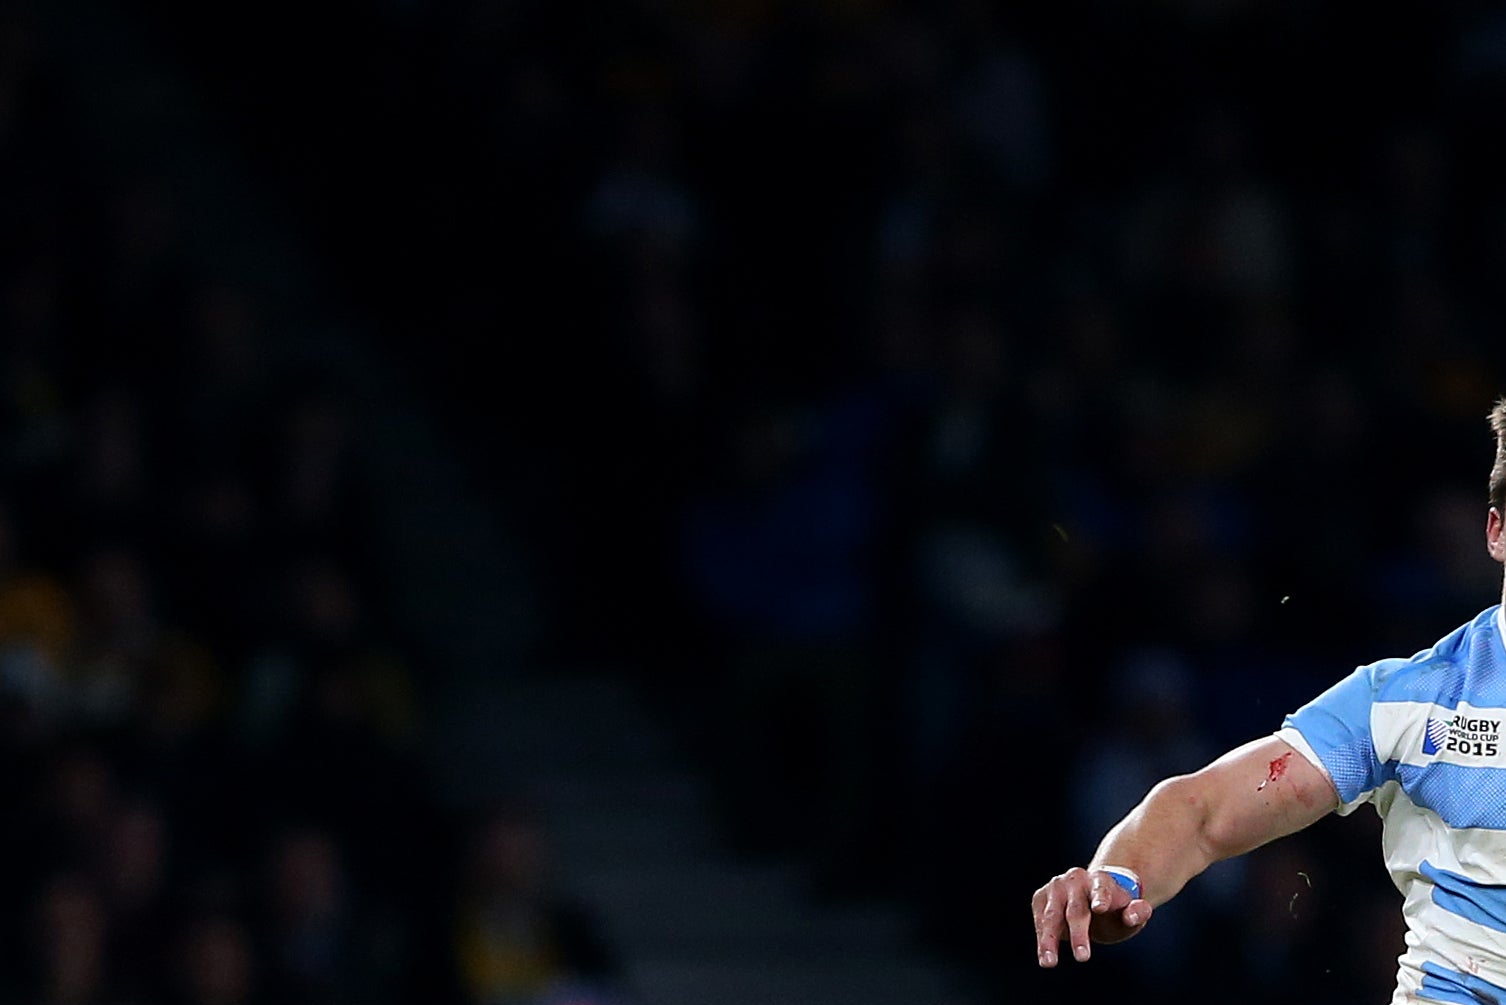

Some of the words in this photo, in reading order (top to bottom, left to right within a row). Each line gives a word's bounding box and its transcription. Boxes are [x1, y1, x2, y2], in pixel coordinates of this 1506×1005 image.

[1453, 715, 1501, 733] RUGBY
[1449, 729, 1478, 741] WORLD
[1480, 733, 1499, 742] CUP
[1446, 736, 1497, 757] 2015
